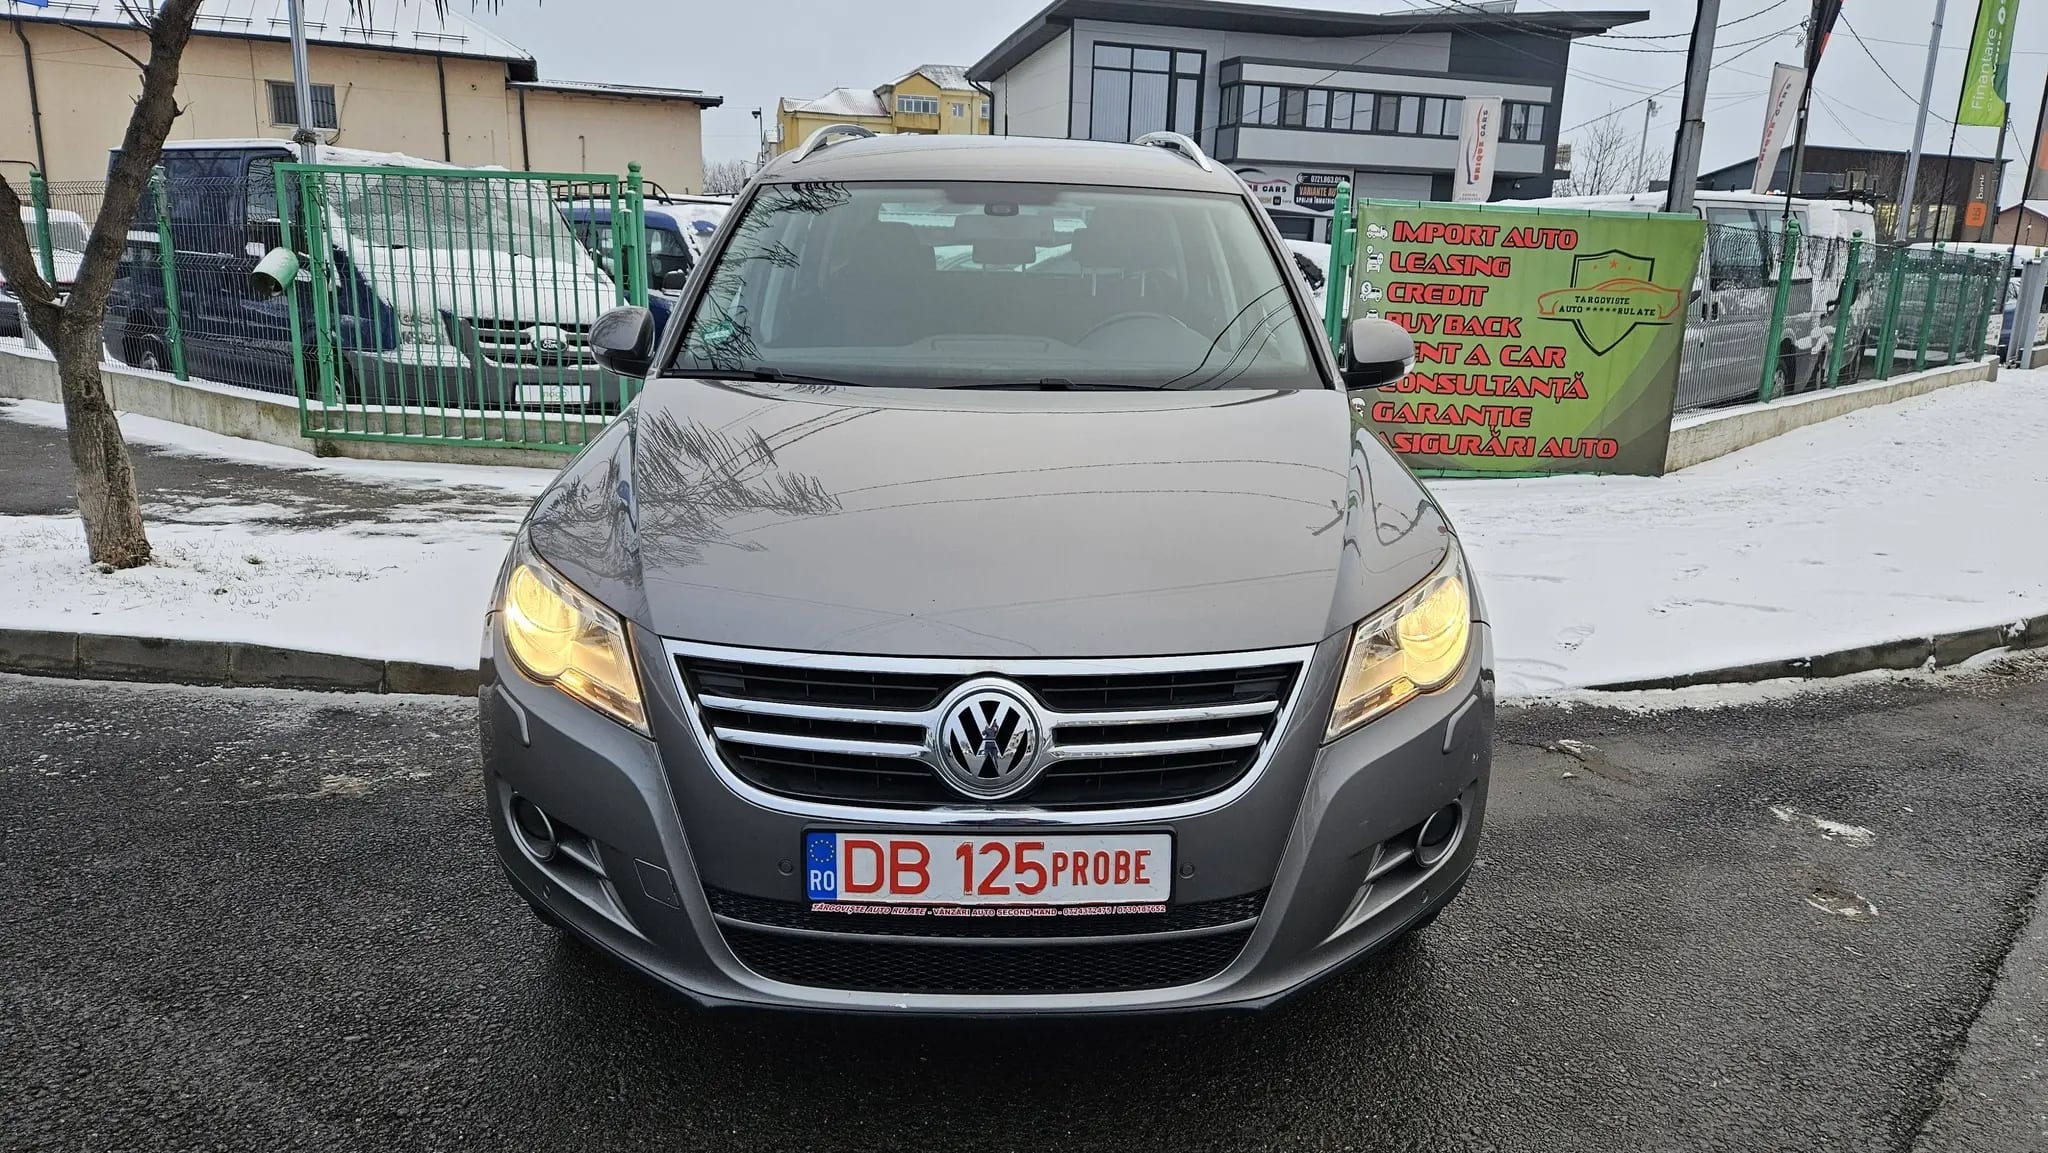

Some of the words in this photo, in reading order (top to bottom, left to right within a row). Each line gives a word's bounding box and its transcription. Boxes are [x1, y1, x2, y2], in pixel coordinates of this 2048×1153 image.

[1480, 110, 1488, 136] CARS
[1262, 185, 1287, 193] CARS
[1300, 186, 1327, 196] VARIANTE
[1976, 175, 1985, 200] bank
[1393, 221, 1500, 246] IMPORT
[1501, 227, 1578, 250] AUTO
[1390, 251, 1511, 278] LEASING
[1387, 282, 1489, 306] CREDIT
[1559, 305, 1583, 313] AUTO
[1617, 307, 1656, 316] RULATE
[1443, 314, 1522, 338] BACK
[1464, 343, 1491, 365] A
[1500, 345, 1566, 368] CAR
[1378, 371, 1589, 403] ONSULTANȚĂ
[1372, 401, 1533, 431] GARANȚIE
[1538, 437, 1619, 459] AUTO
[844, 840, 931, 894] DB
[955, 841, 1048, 896] 125
[1052, 849, 1152, 886] PROBE
[810, 870, 834, 891] RO
[865, 905, 891, 914] AUTO
[891, 906, 927, 916] RULATE
[971, 908, 995, 916] AUTO
